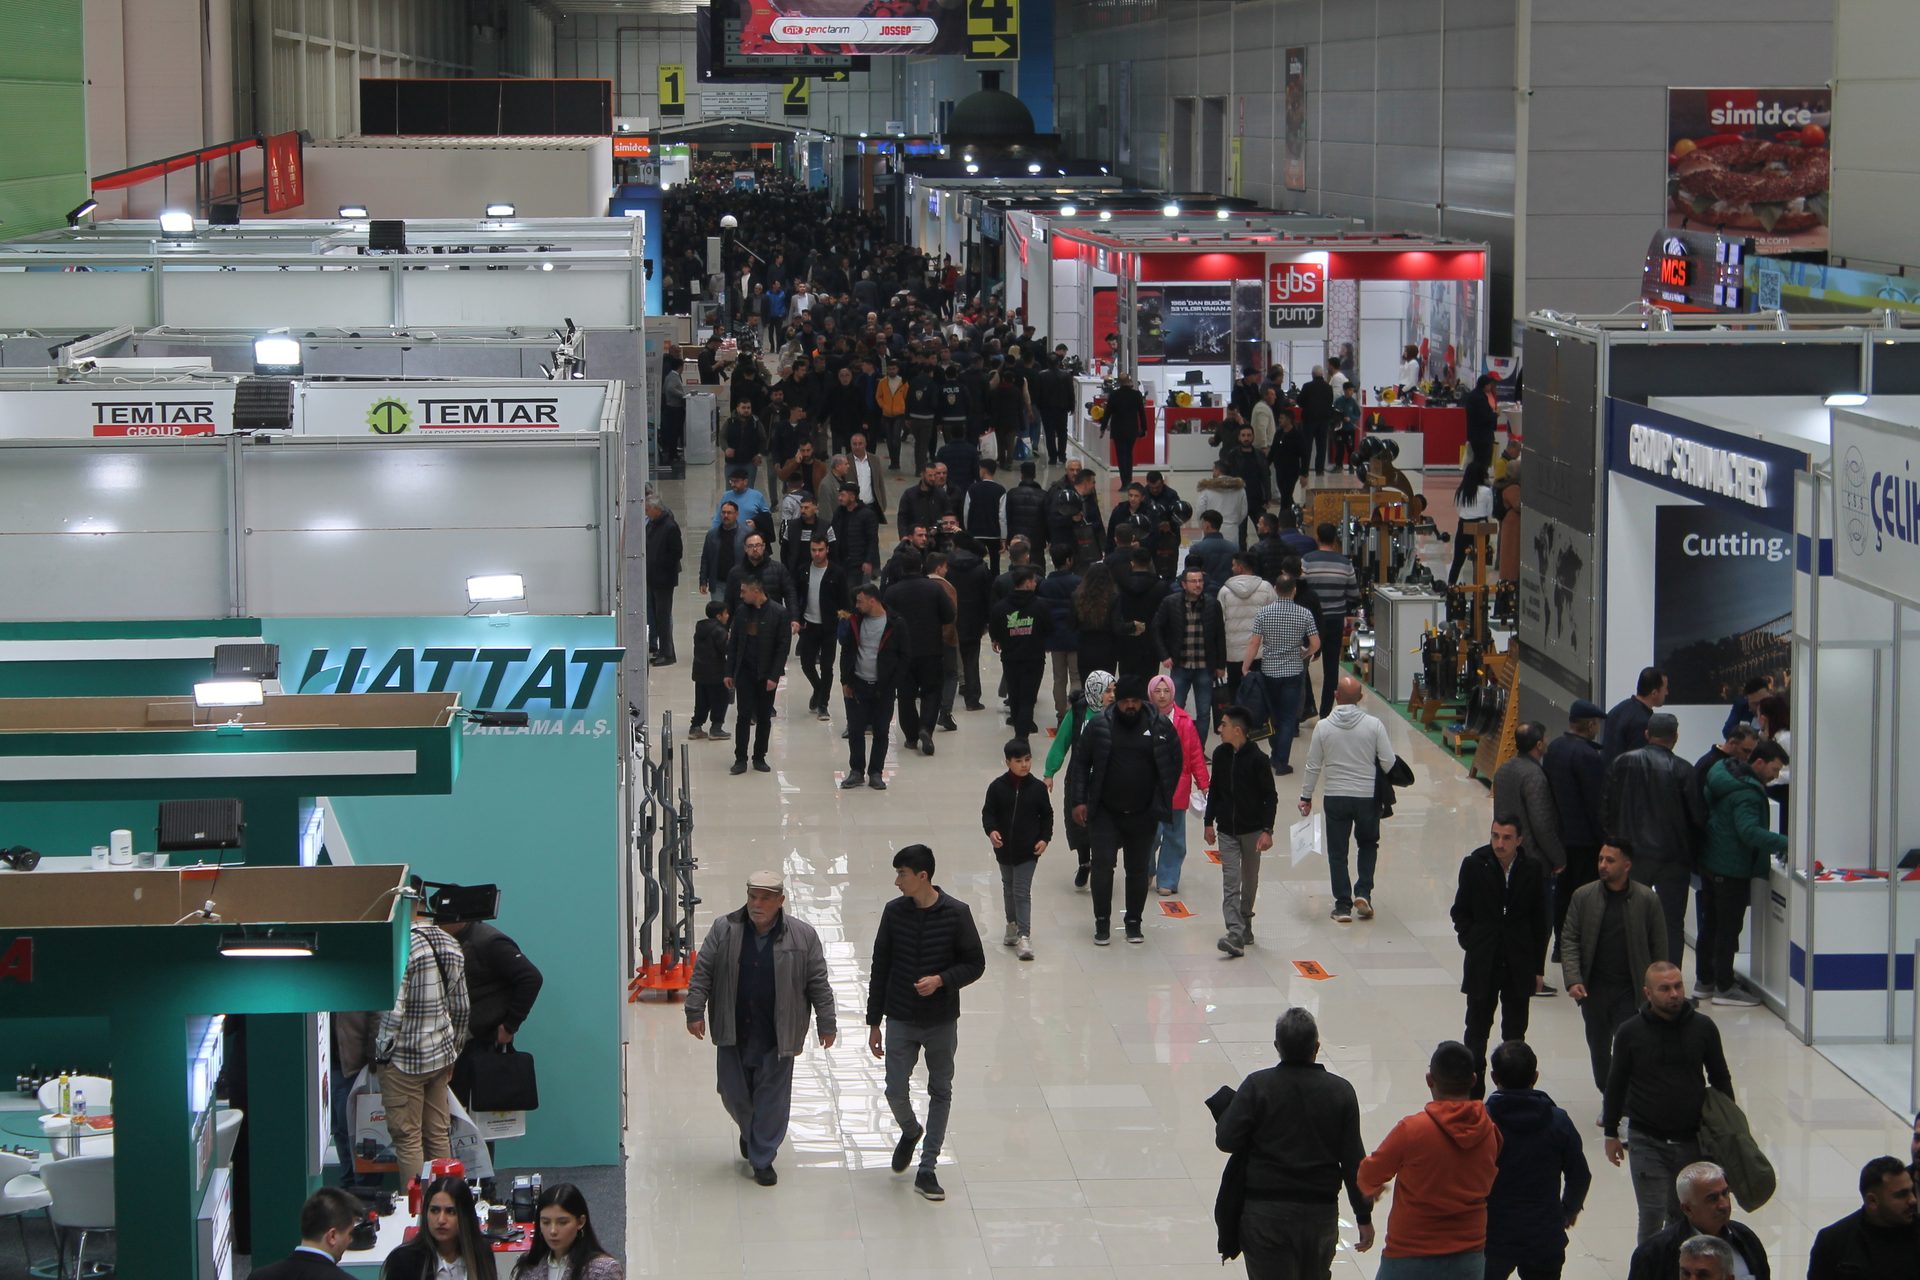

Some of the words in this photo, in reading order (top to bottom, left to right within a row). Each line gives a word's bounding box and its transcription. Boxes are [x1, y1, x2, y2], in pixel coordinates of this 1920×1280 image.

[969, 0, 1013, 32] 4
[665, 72, 678, 103] 1
[787, 77, 806, 103] 2
[1276, 266, 1316, 300] ybs
[1661, 257, 1687, 287] MCS
[1276, 307, 1316, 325] pump
[126, 426, 182, 436] GROUP
[1629, 423, 1672, 475] GROUP
[1671, 437, 1768, 508] SCHUMACHER
[1682, 531, 1791, 562] Cutting.
[297, 646, 627, 710] HATTAT
